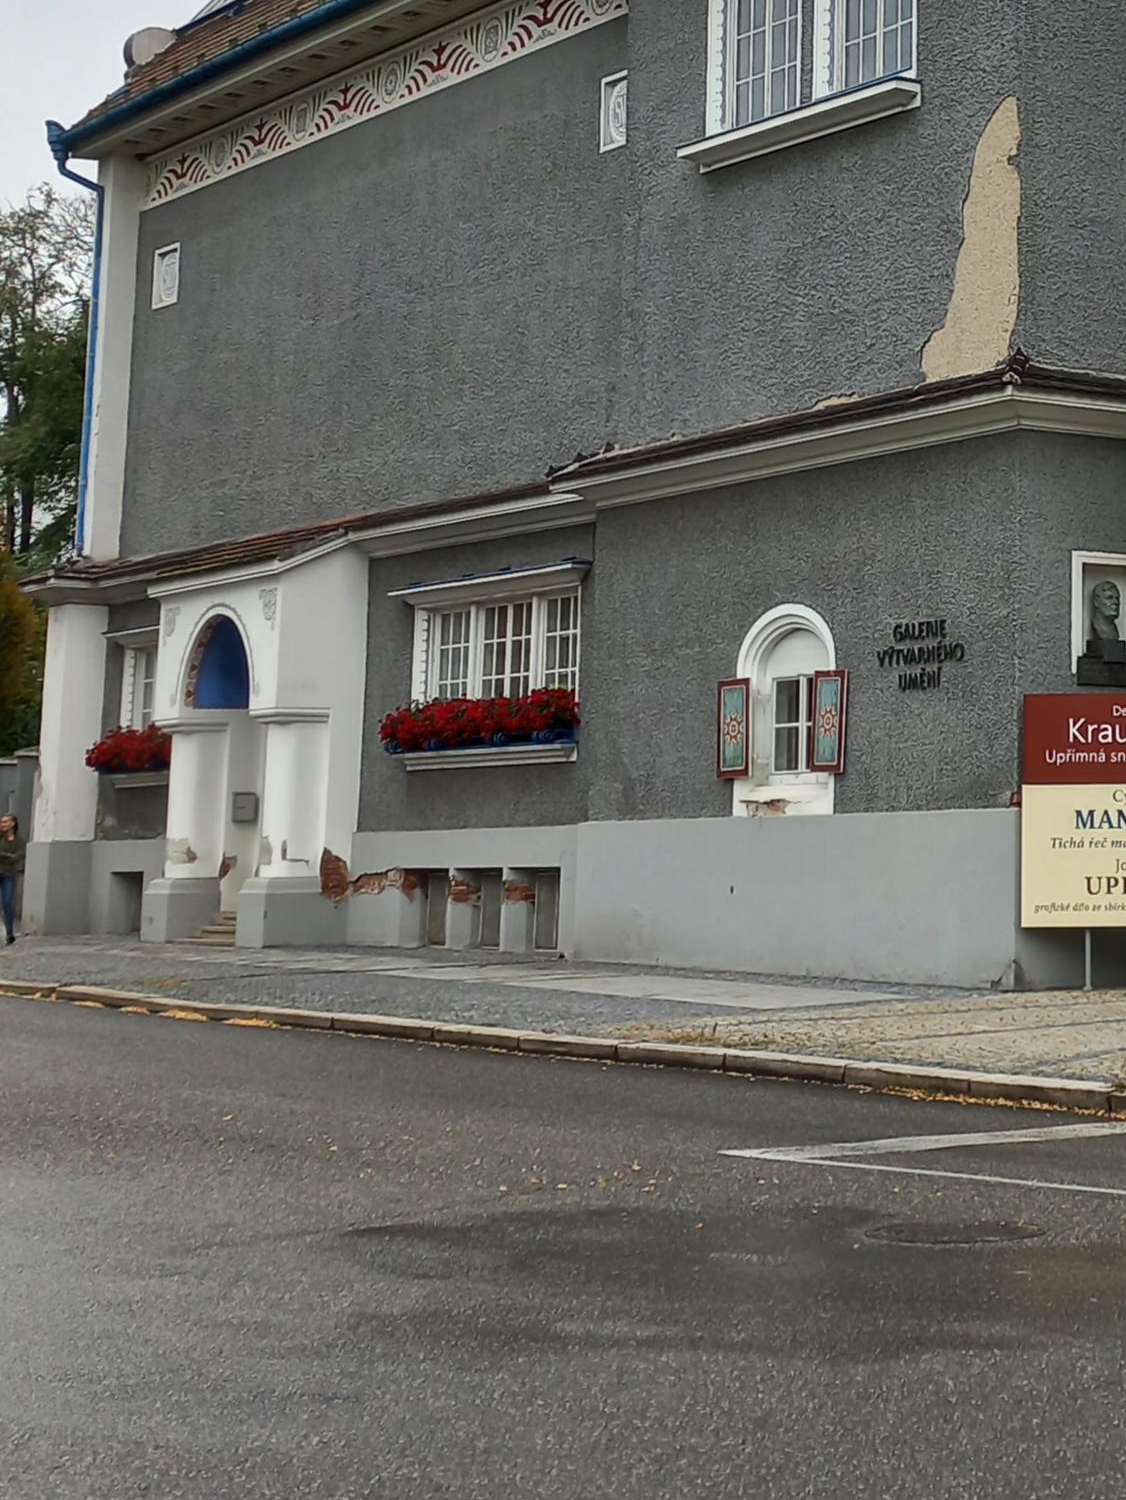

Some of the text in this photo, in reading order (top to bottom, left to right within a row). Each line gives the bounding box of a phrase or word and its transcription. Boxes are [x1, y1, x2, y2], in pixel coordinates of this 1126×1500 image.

[893, 619, 947, 642] GALERIE
[876, 640, 965, 668] VÝTVARNÉHO
[898, 666, 942, 693] UMĚNÍ
[1045, 749, 1106, 766] Upřímná
[1050, 837, 1085, 849] Tichá
[1088, 838, 1108, 849] řeč
